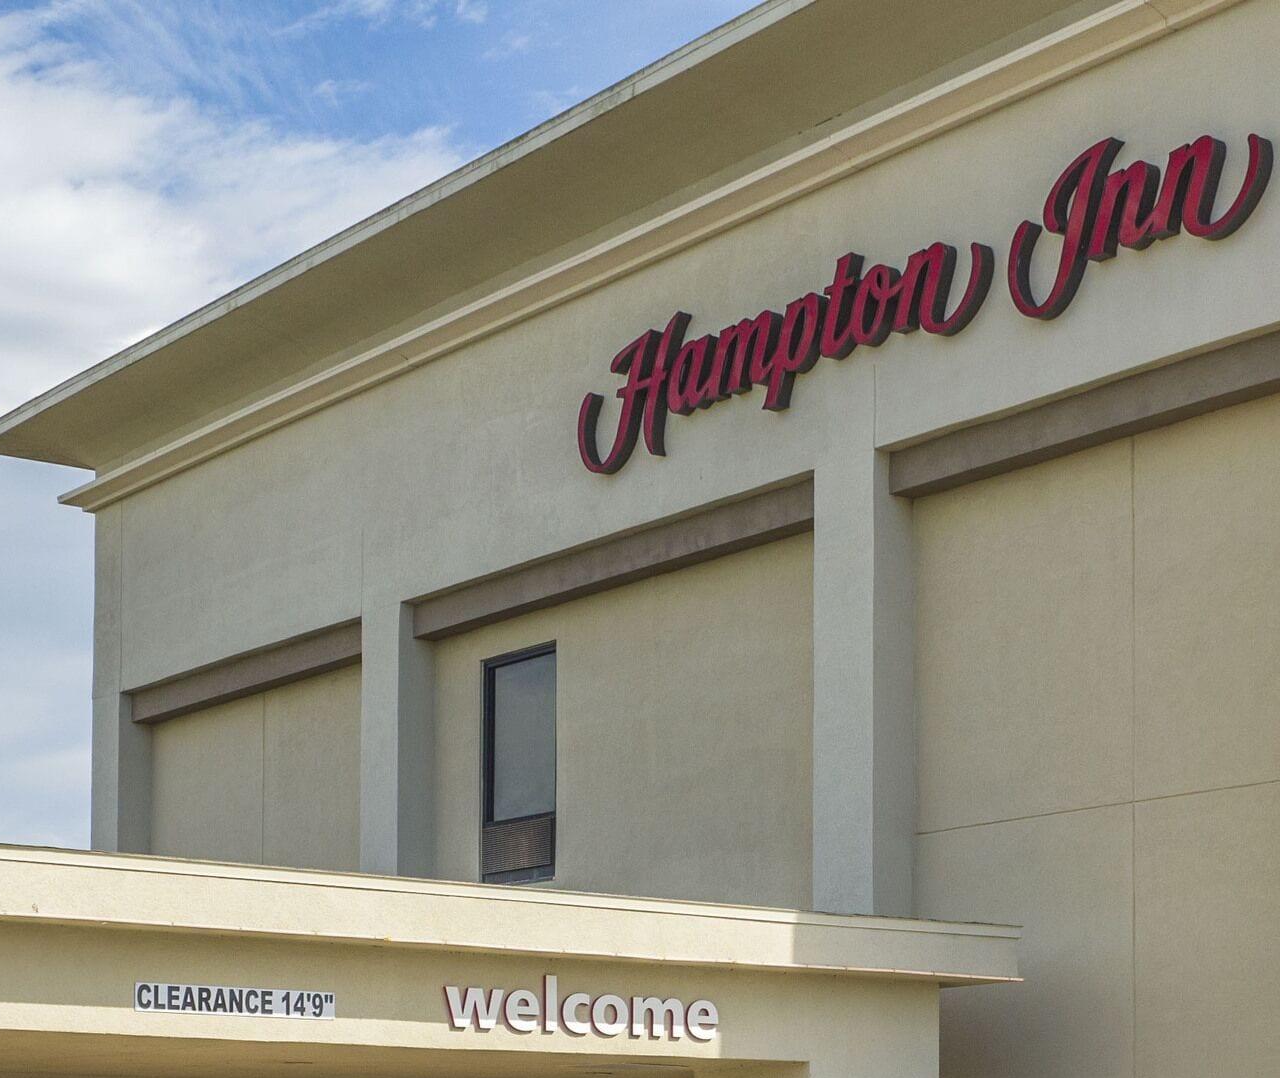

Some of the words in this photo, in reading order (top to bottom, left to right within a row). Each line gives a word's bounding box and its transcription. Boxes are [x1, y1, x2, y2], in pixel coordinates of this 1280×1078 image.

[578, 242, 994, 475] Hampton
[1008, 134, 1274, 320] Inn
[137, 984, 273, 1015] CLEARANCE
[281, 991, 334, 1017] 14'9"
[444, 975, 718, 1040] welcome
